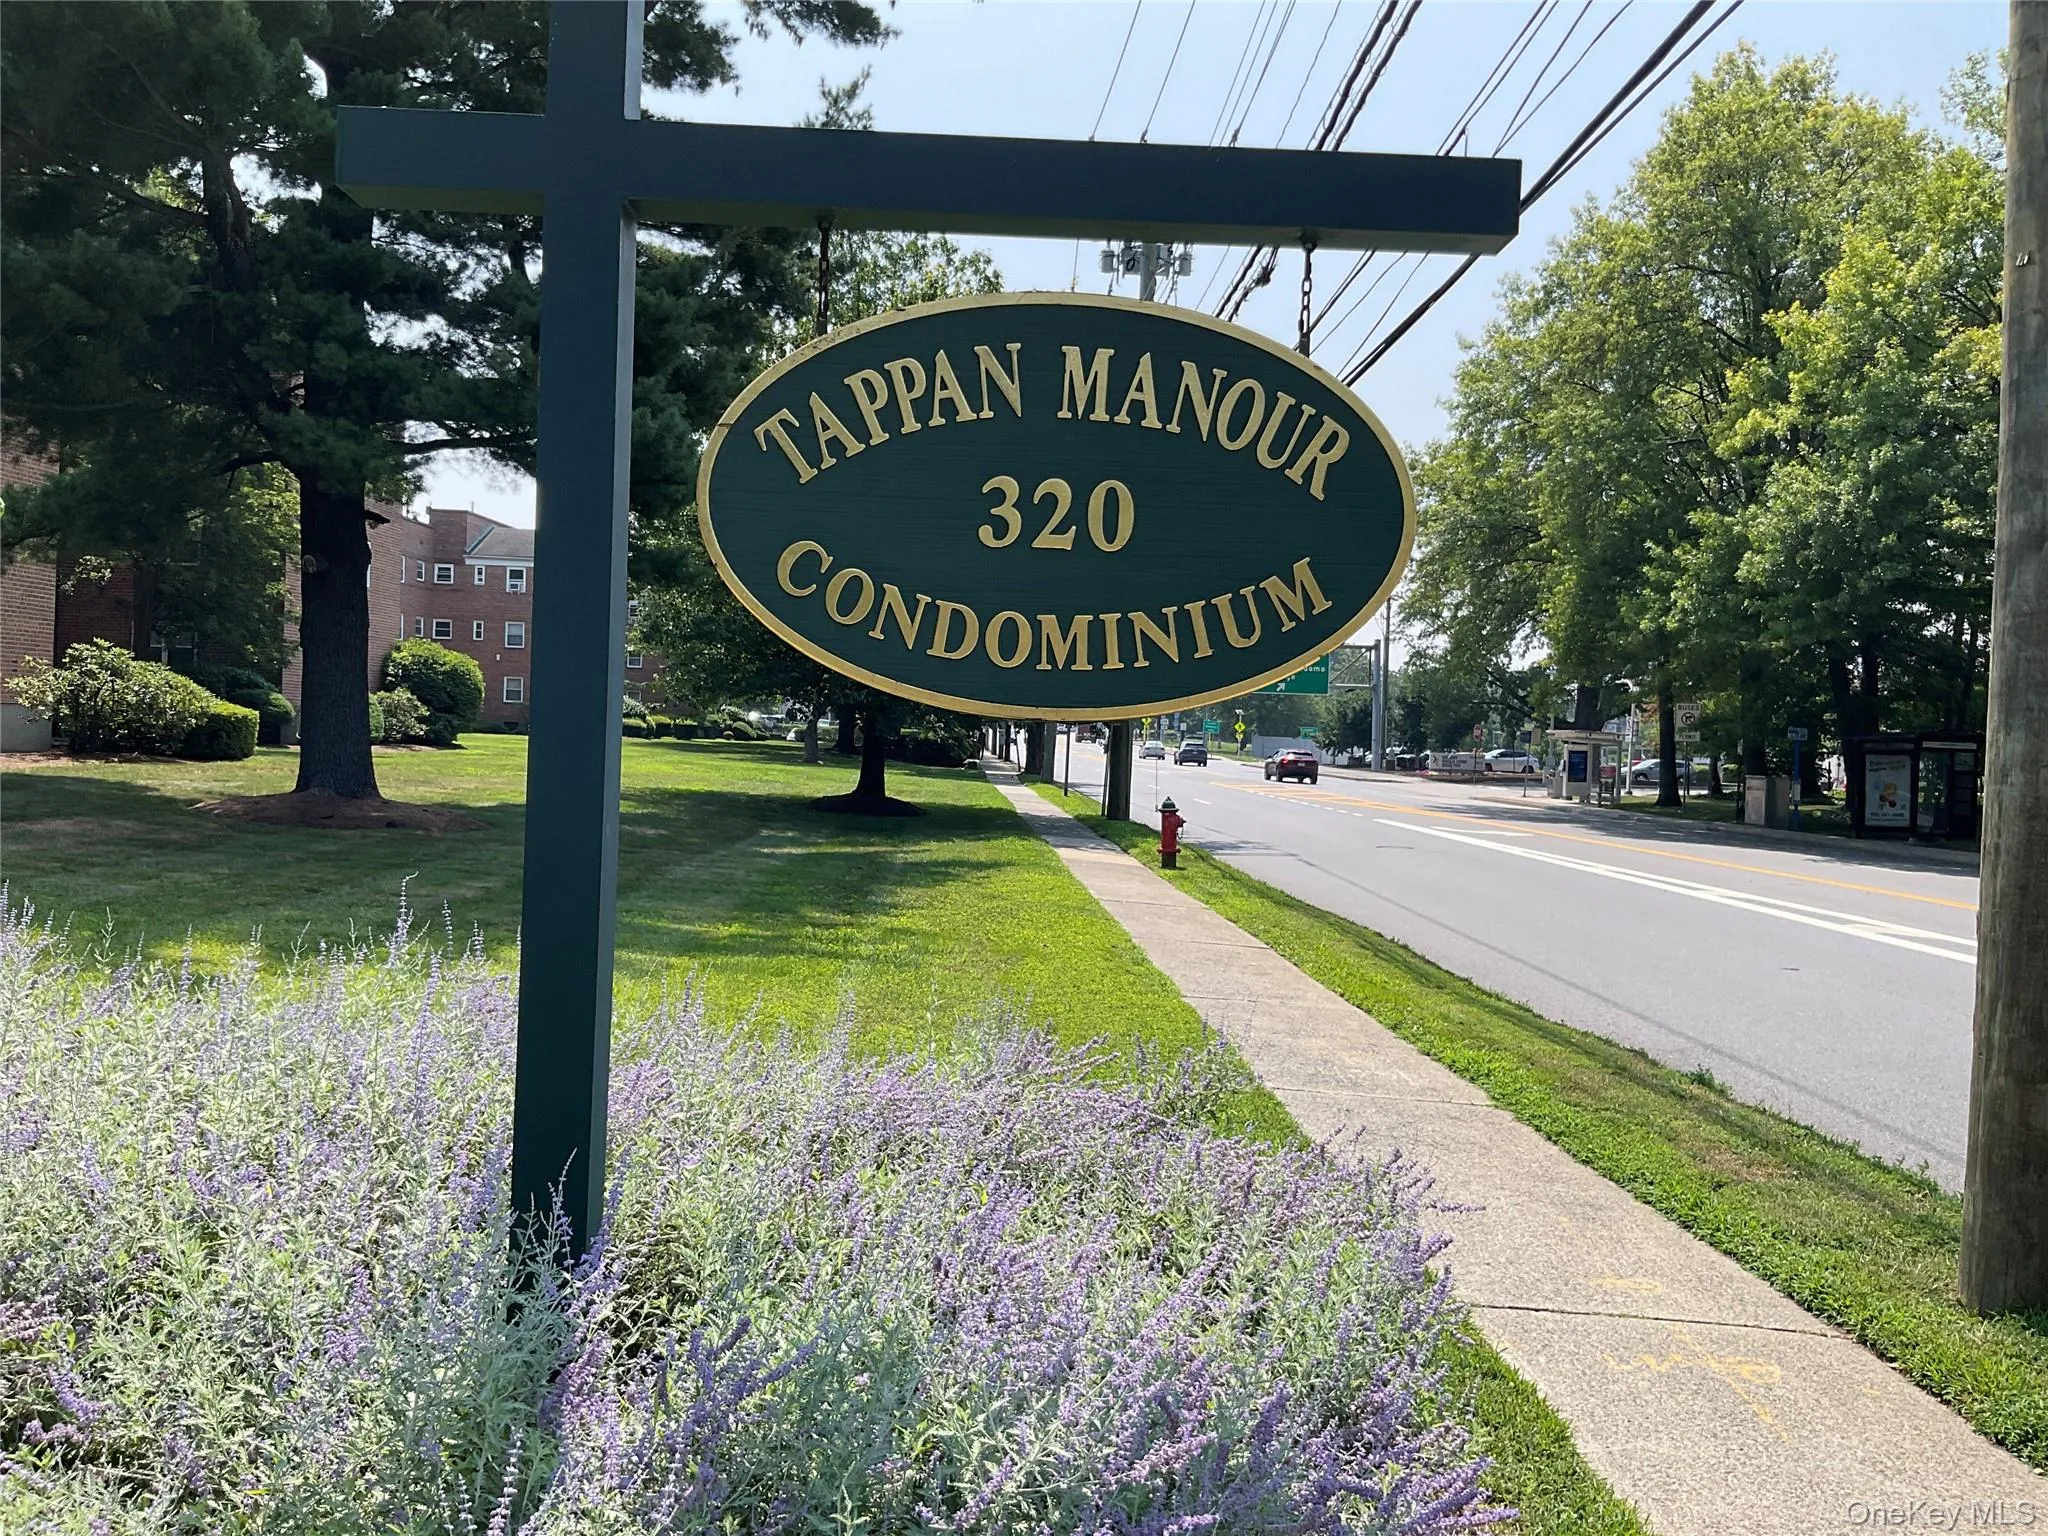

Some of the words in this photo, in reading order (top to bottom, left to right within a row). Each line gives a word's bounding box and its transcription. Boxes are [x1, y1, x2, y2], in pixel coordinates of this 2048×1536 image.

[754, 342, 1022, 484] TAPPAN
[1057, 346, 1349, 500] MANOUR
[978, 476, 1135, 551] 320
[777, 541, 1332, 669] CONDOMINIUM
